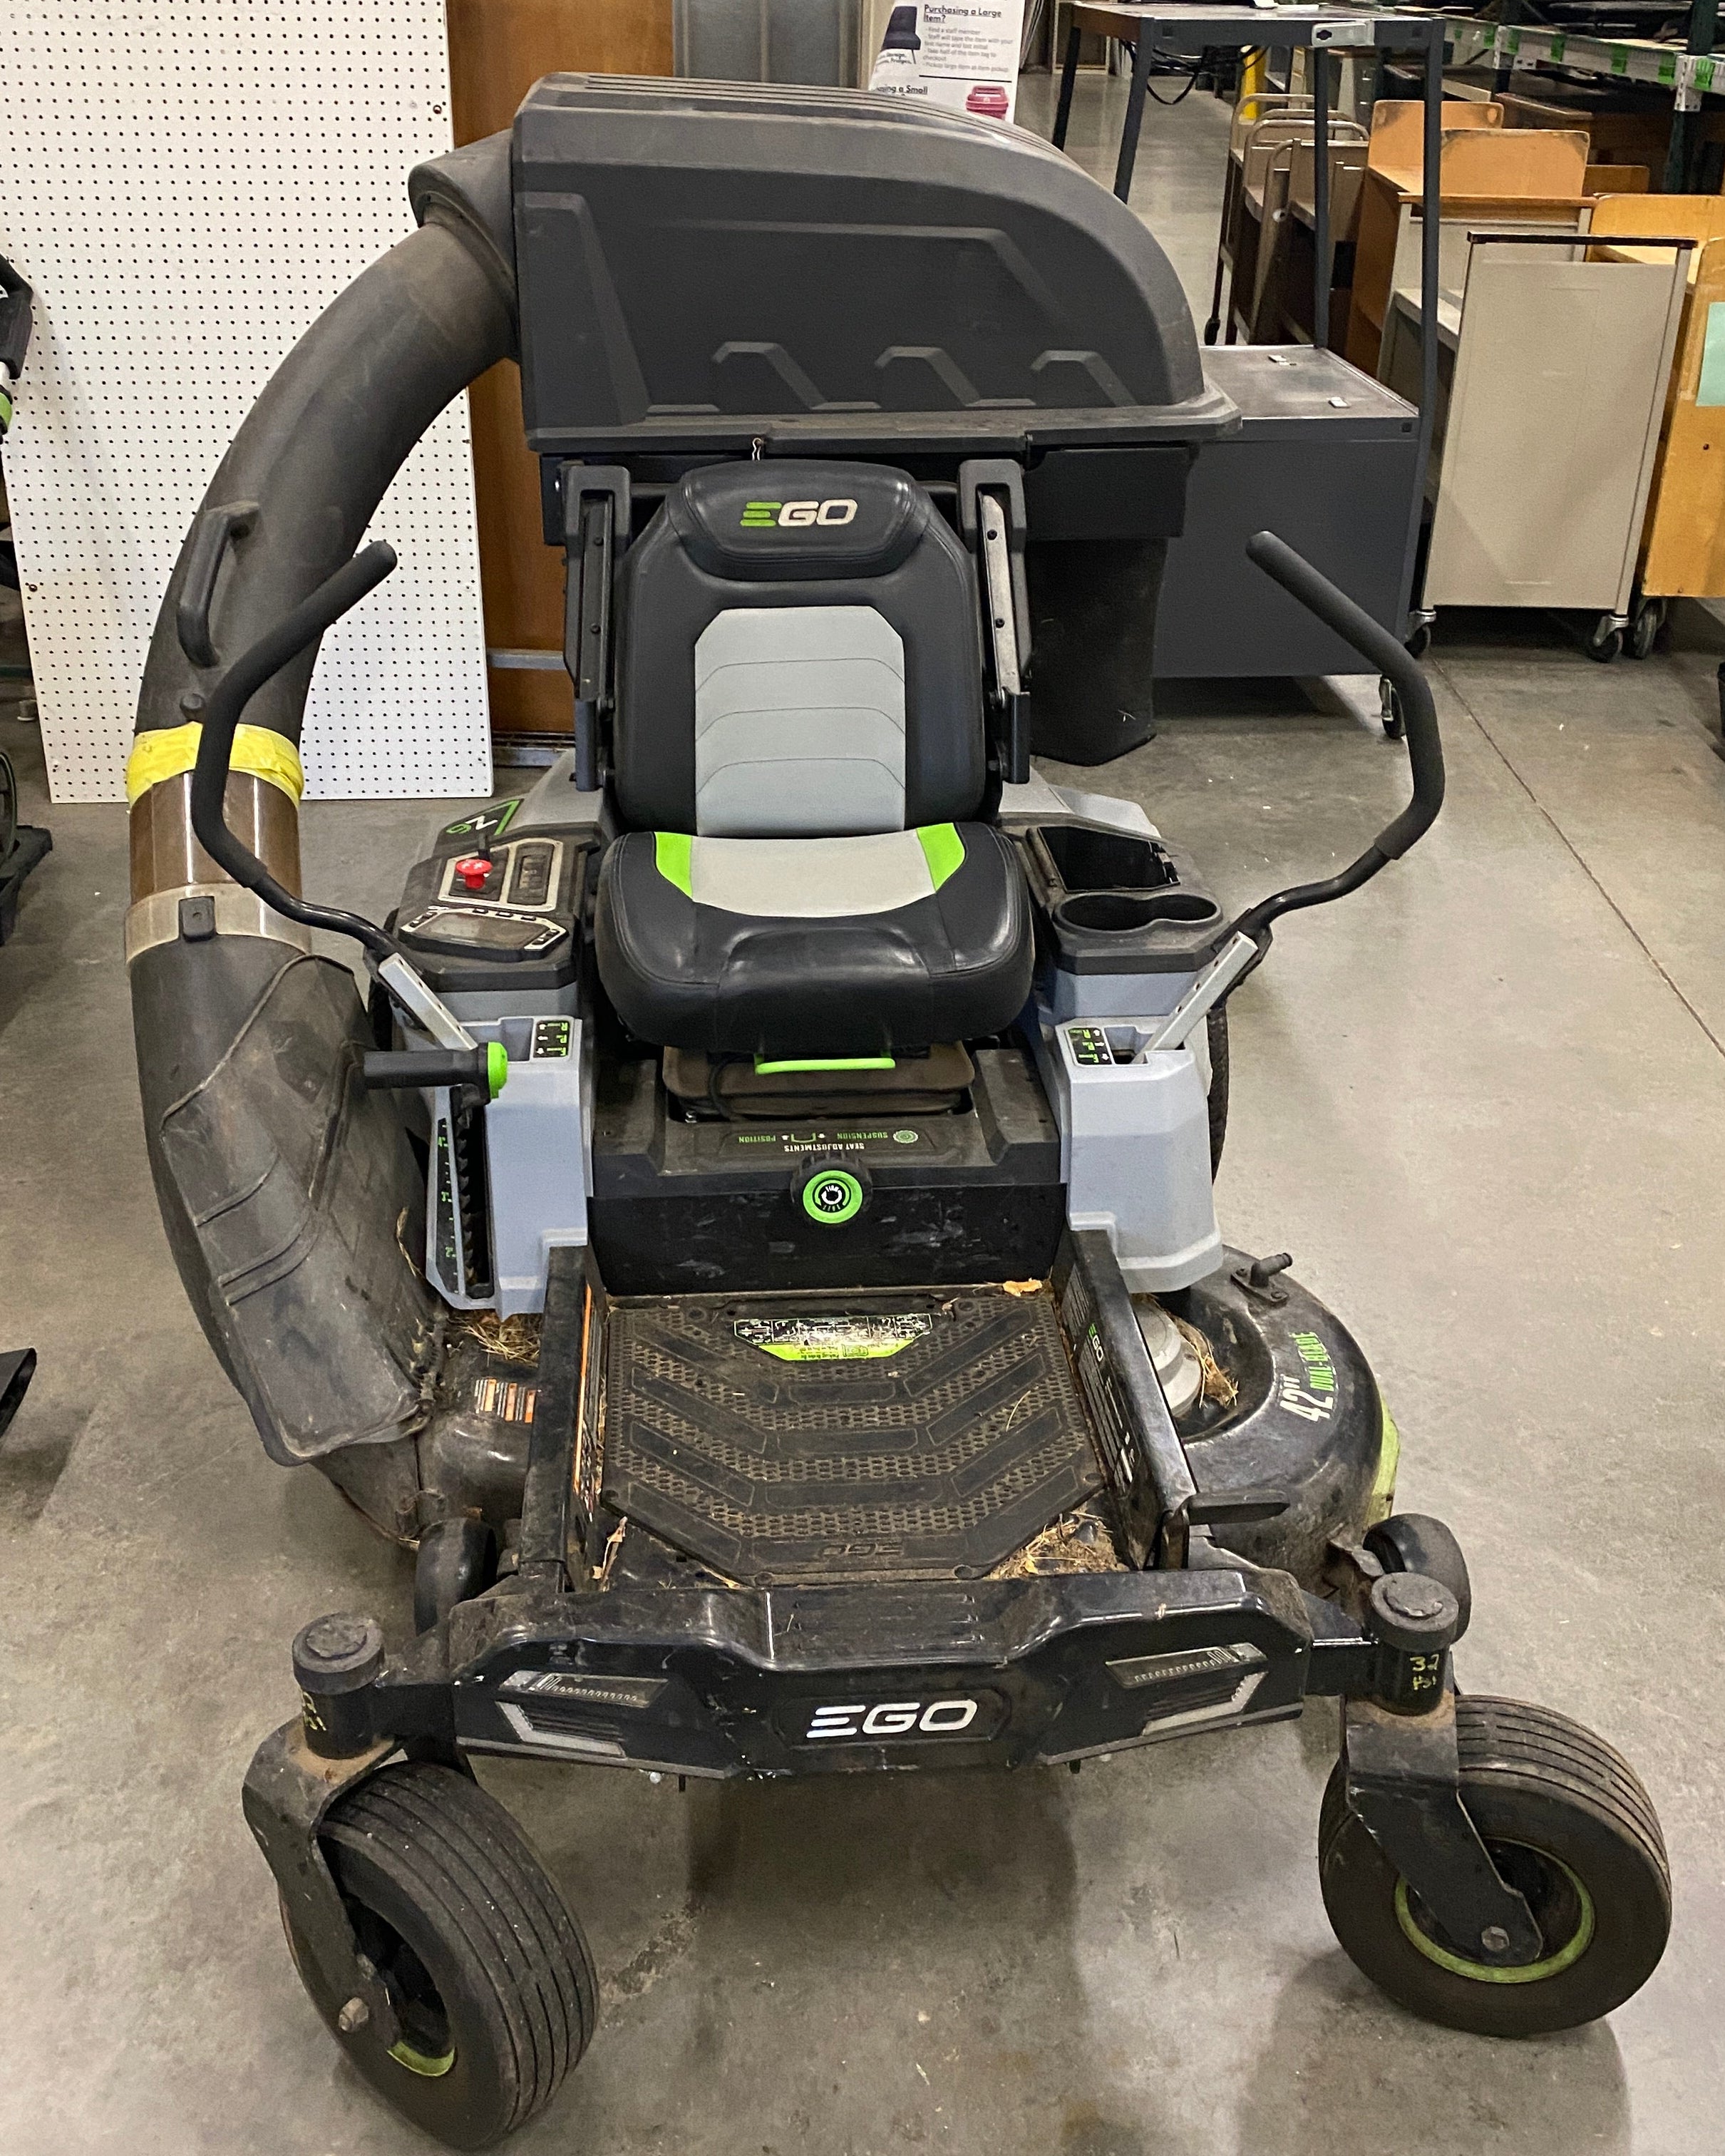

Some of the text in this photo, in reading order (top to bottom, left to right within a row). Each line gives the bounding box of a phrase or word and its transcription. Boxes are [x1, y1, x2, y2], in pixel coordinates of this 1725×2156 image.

[925, 4, 969, 16] Purchasing
[979, 8, 1001, 18] Large
[907, 85, 927, 95] Small
[740, 498, 858, 526] EGO
[837, 1131, 889, 1140] SUSPENSION
[784, 1144, 843, 1153] ADJUSTMENTS
[1088, 1323, 1104, 1362] EGO
[1279, 1375, 1334, 1422] 42"
[806, 1699, 978, 1738] EGO
